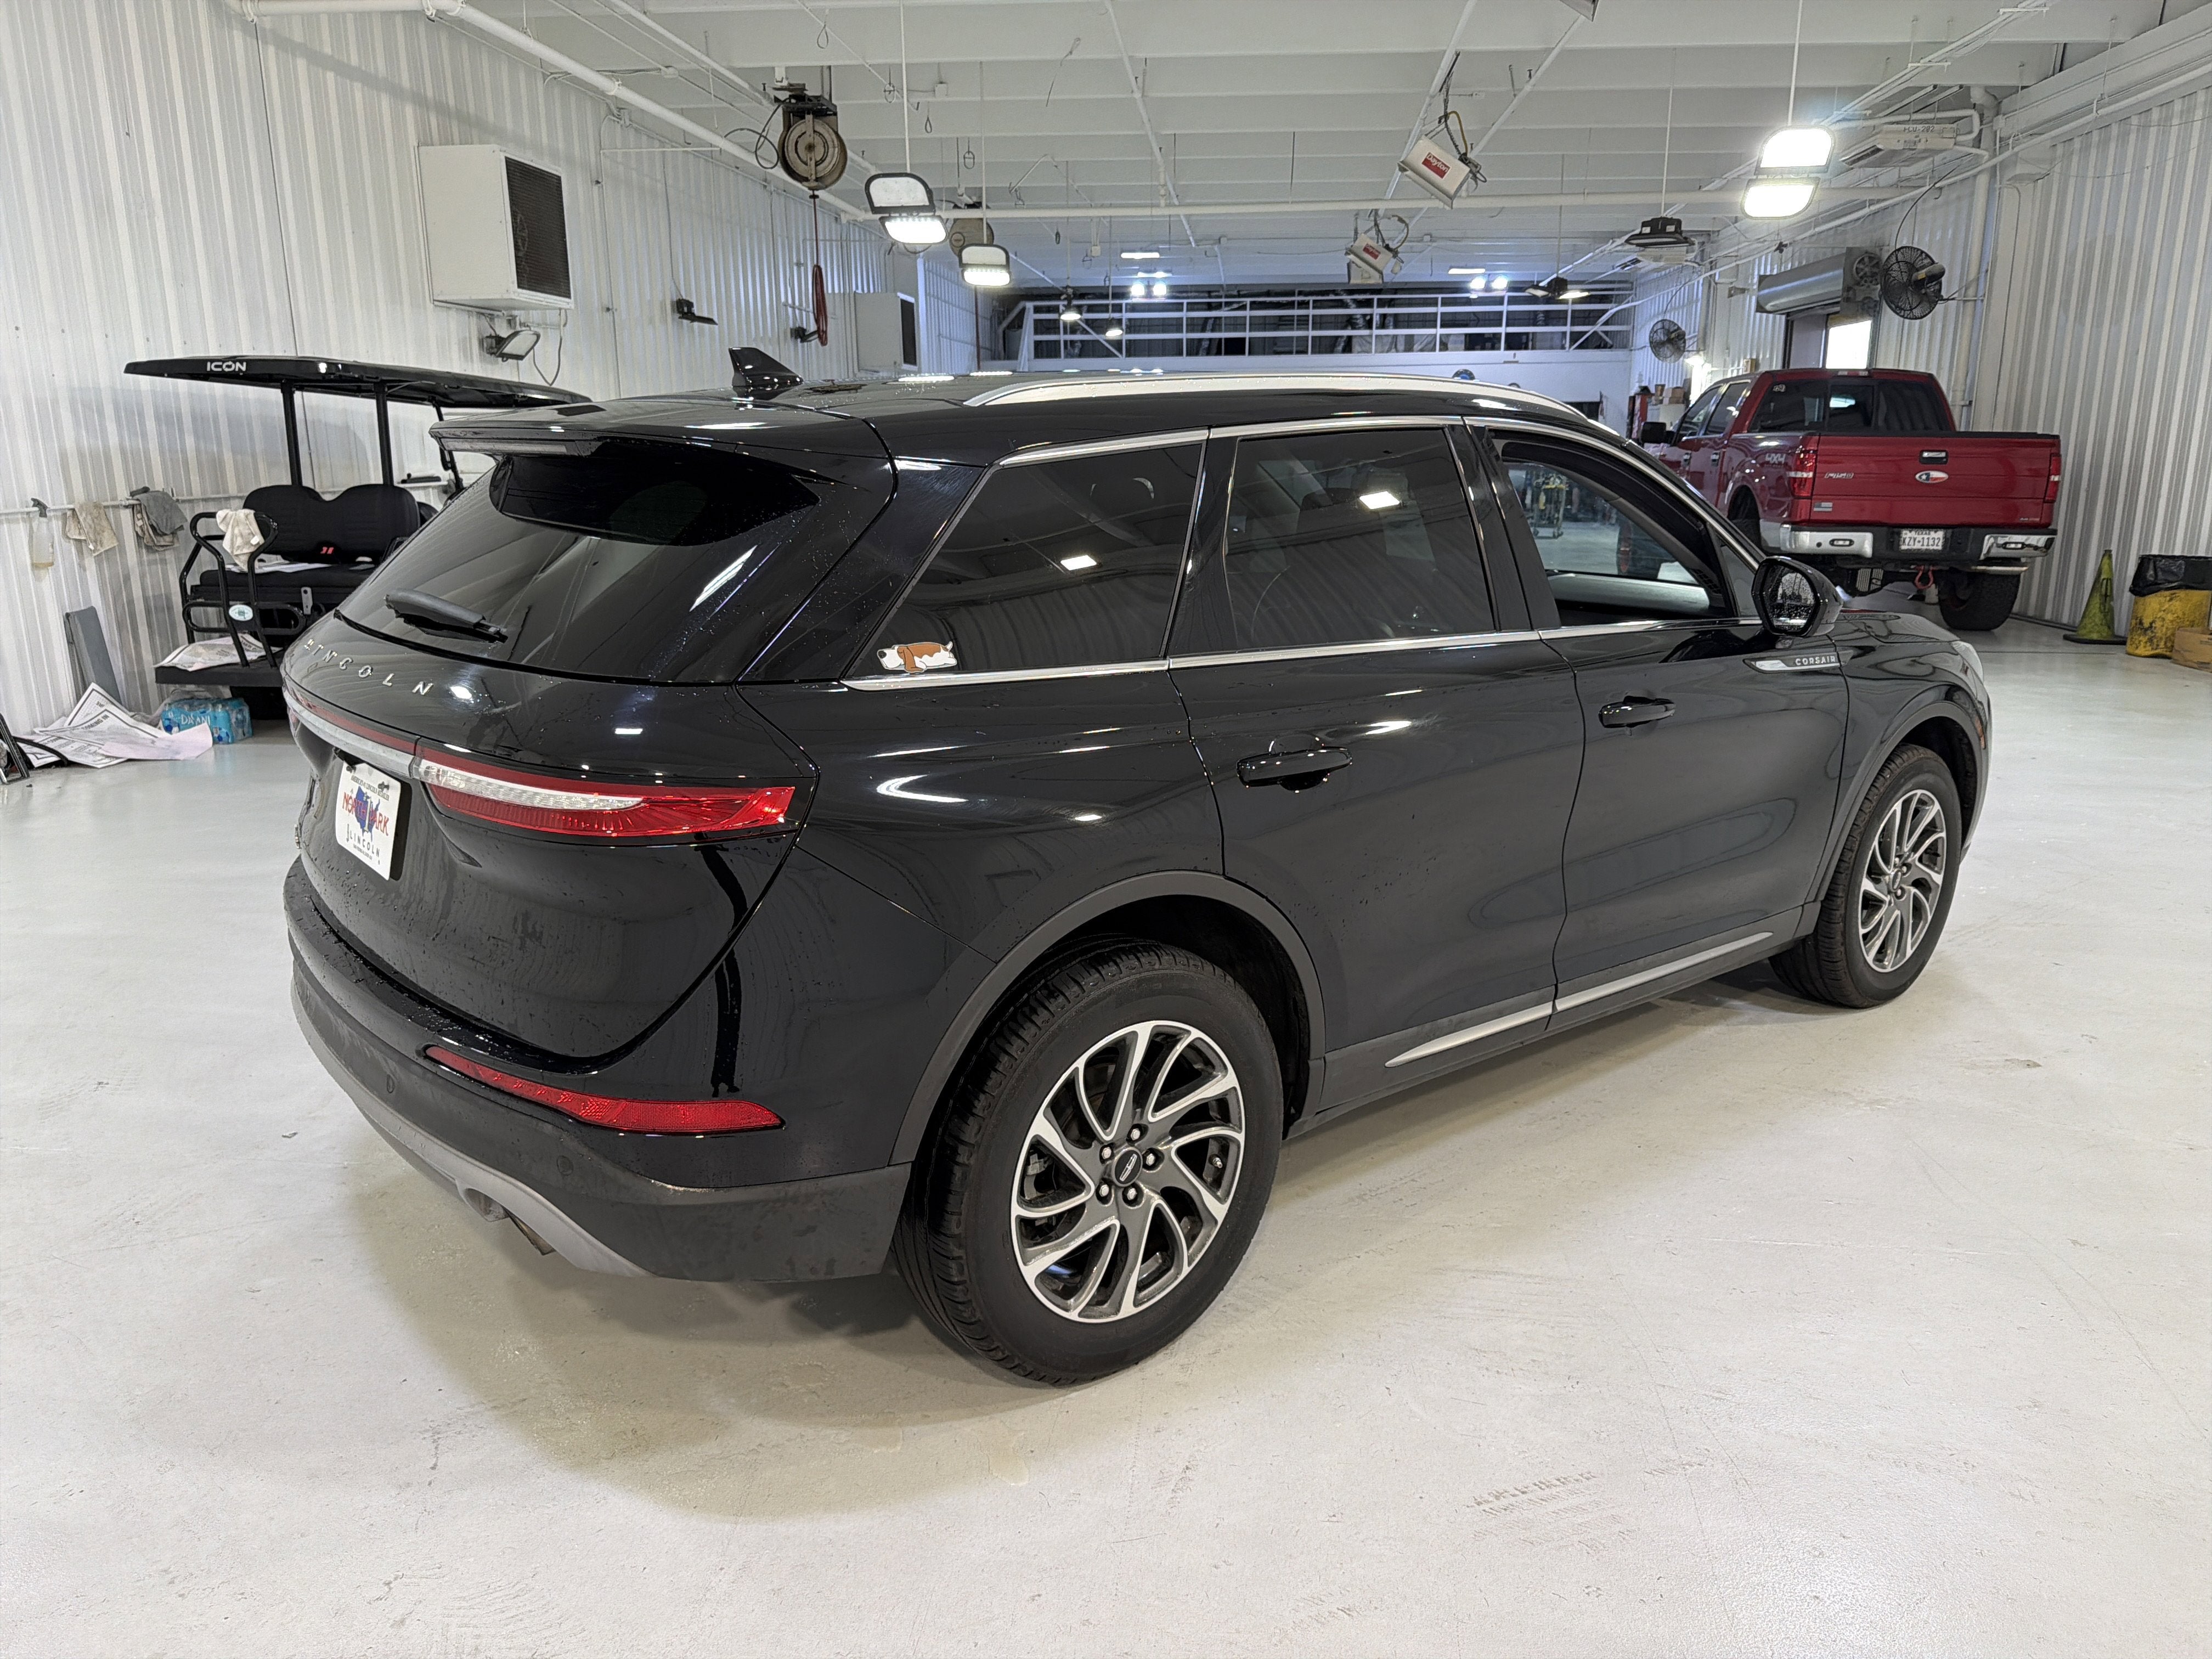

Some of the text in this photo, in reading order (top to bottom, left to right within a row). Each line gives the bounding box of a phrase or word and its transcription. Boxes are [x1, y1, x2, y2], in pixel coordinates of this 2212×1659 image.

[1426, 154, 1448, 172] Dayton
[206, 361, 246, 372] ICON
[304, 639, 434, 695] LINCOLN
[1795, 656, 1836, 665] CORSAIR
[349, 830, 380, 857] LINCOLN
